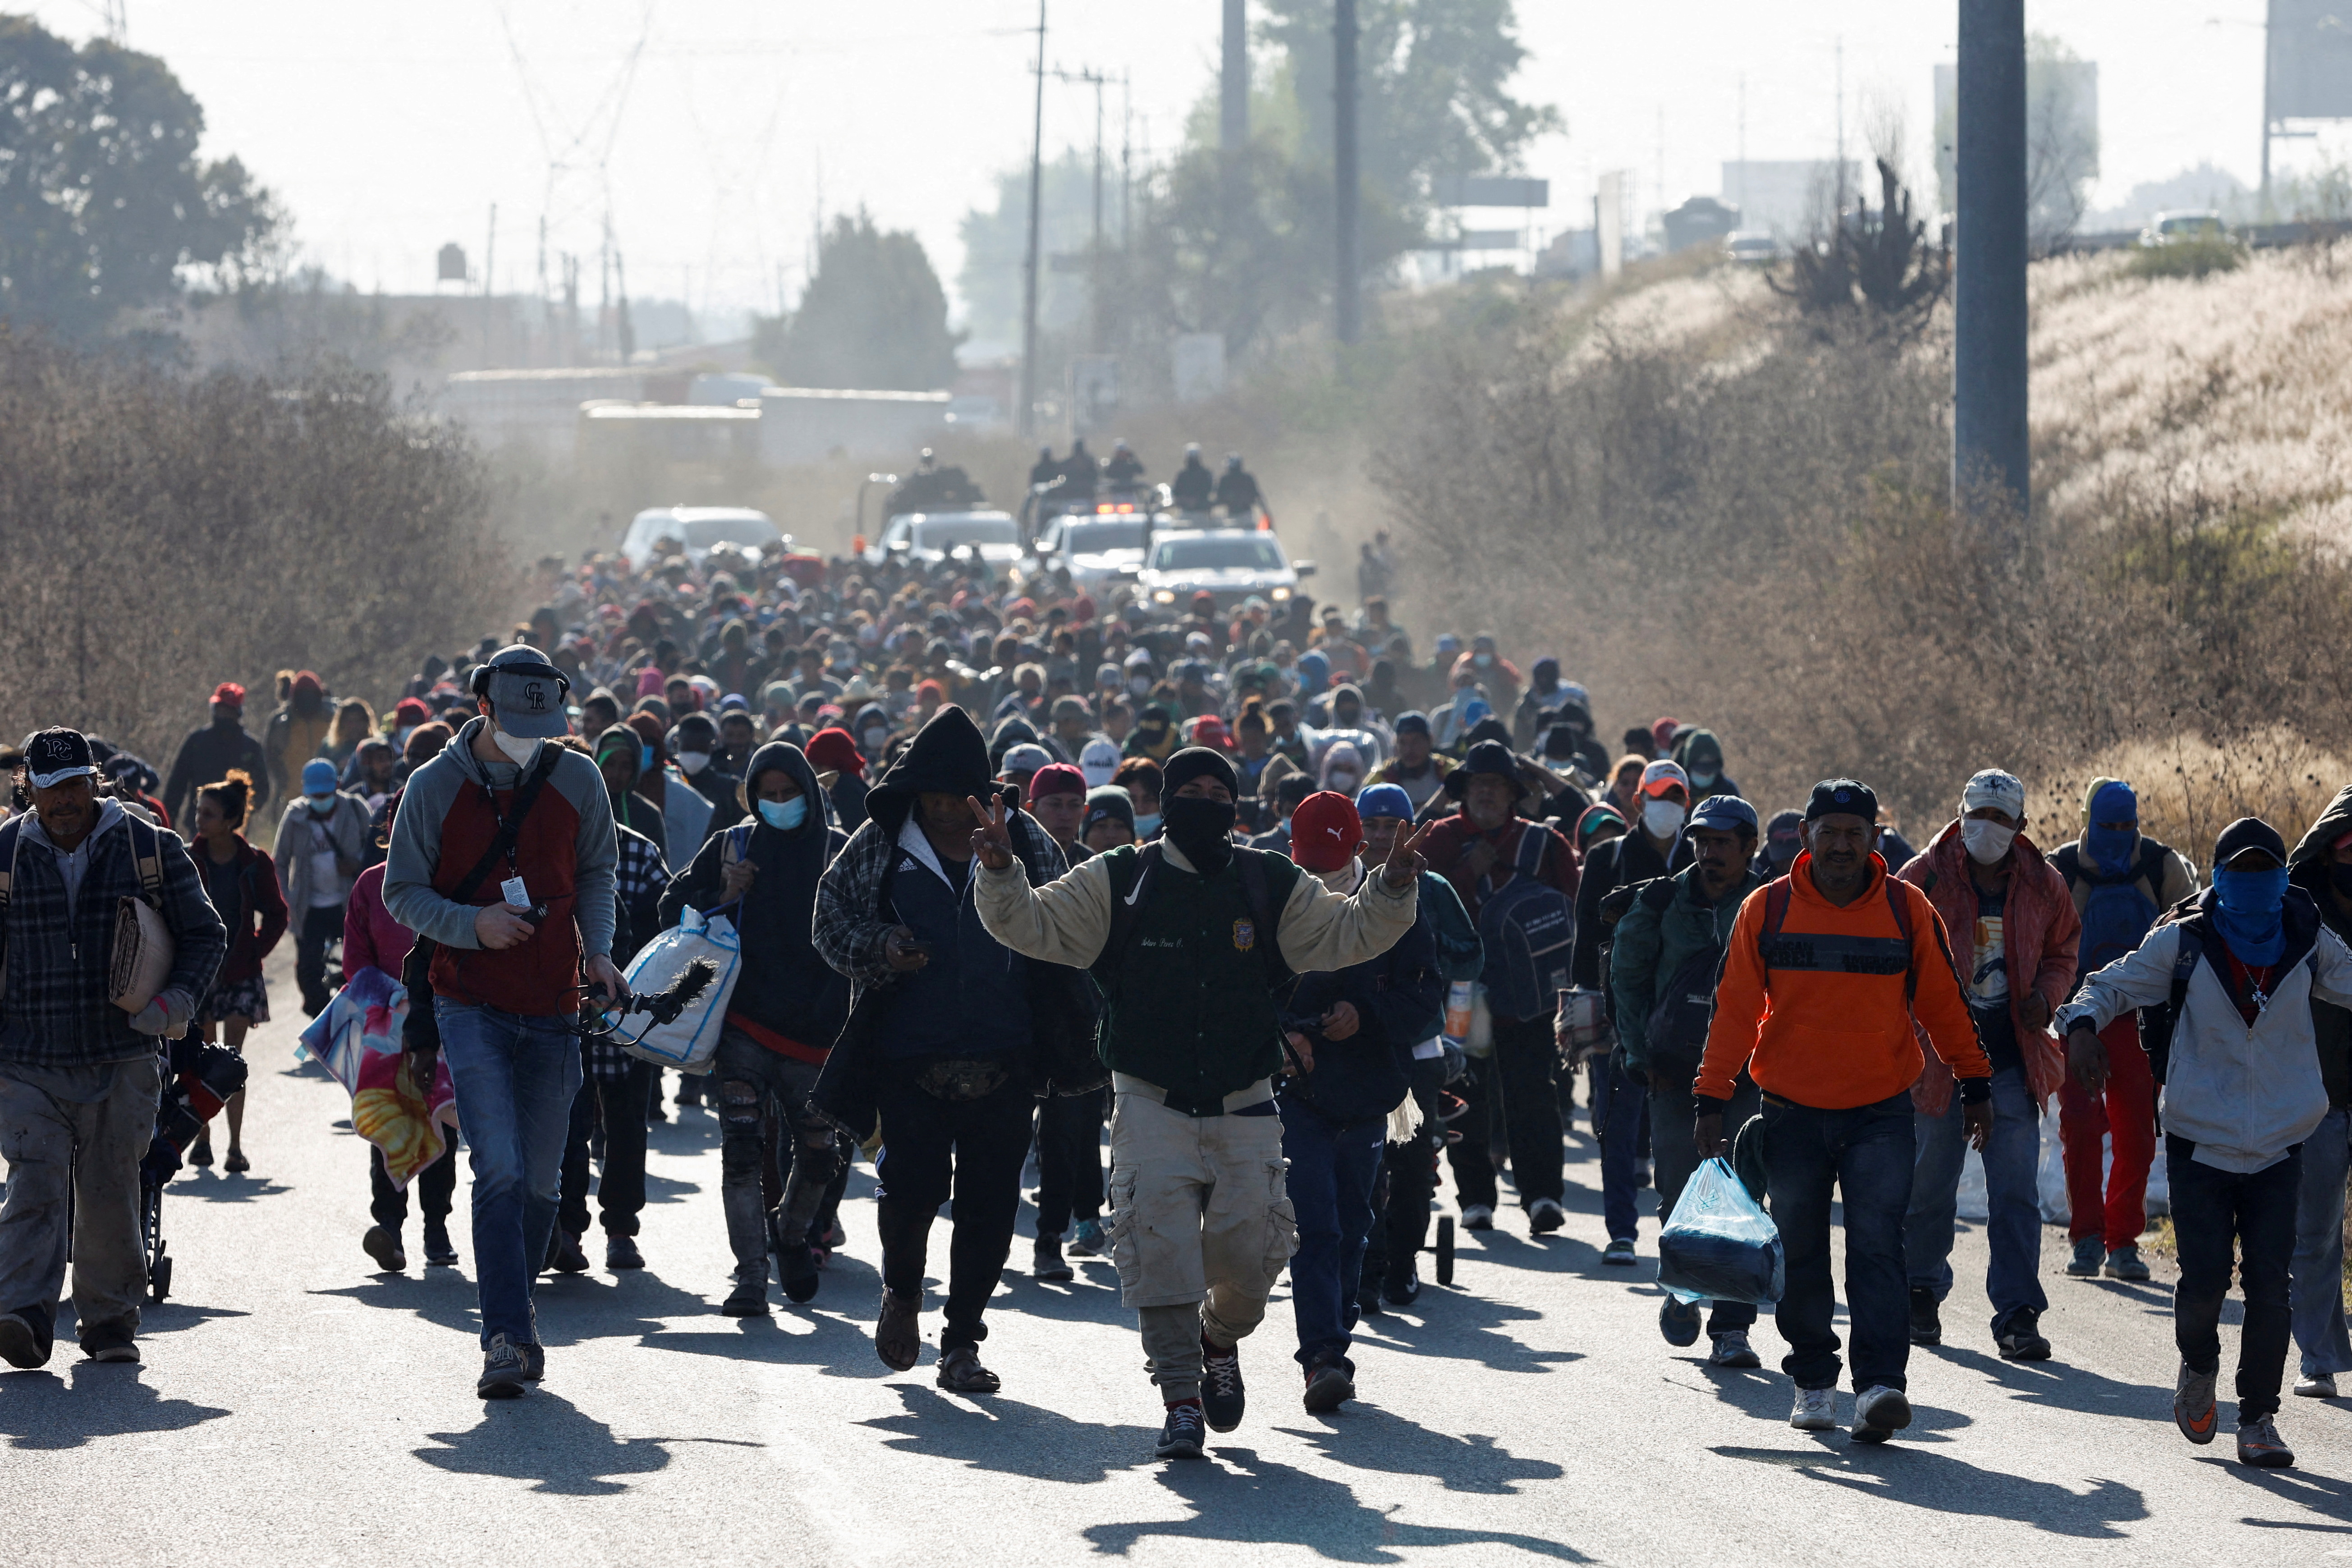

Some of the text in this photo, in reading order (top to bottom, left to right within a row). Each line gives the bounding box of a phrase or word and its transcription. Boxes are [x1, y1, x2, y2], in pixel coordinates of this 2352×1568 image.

[46, 738, 72, 761] DC
[2321, 922, 2336, 938] PUMA
[1767, 951, 1819, 967] EBEL
